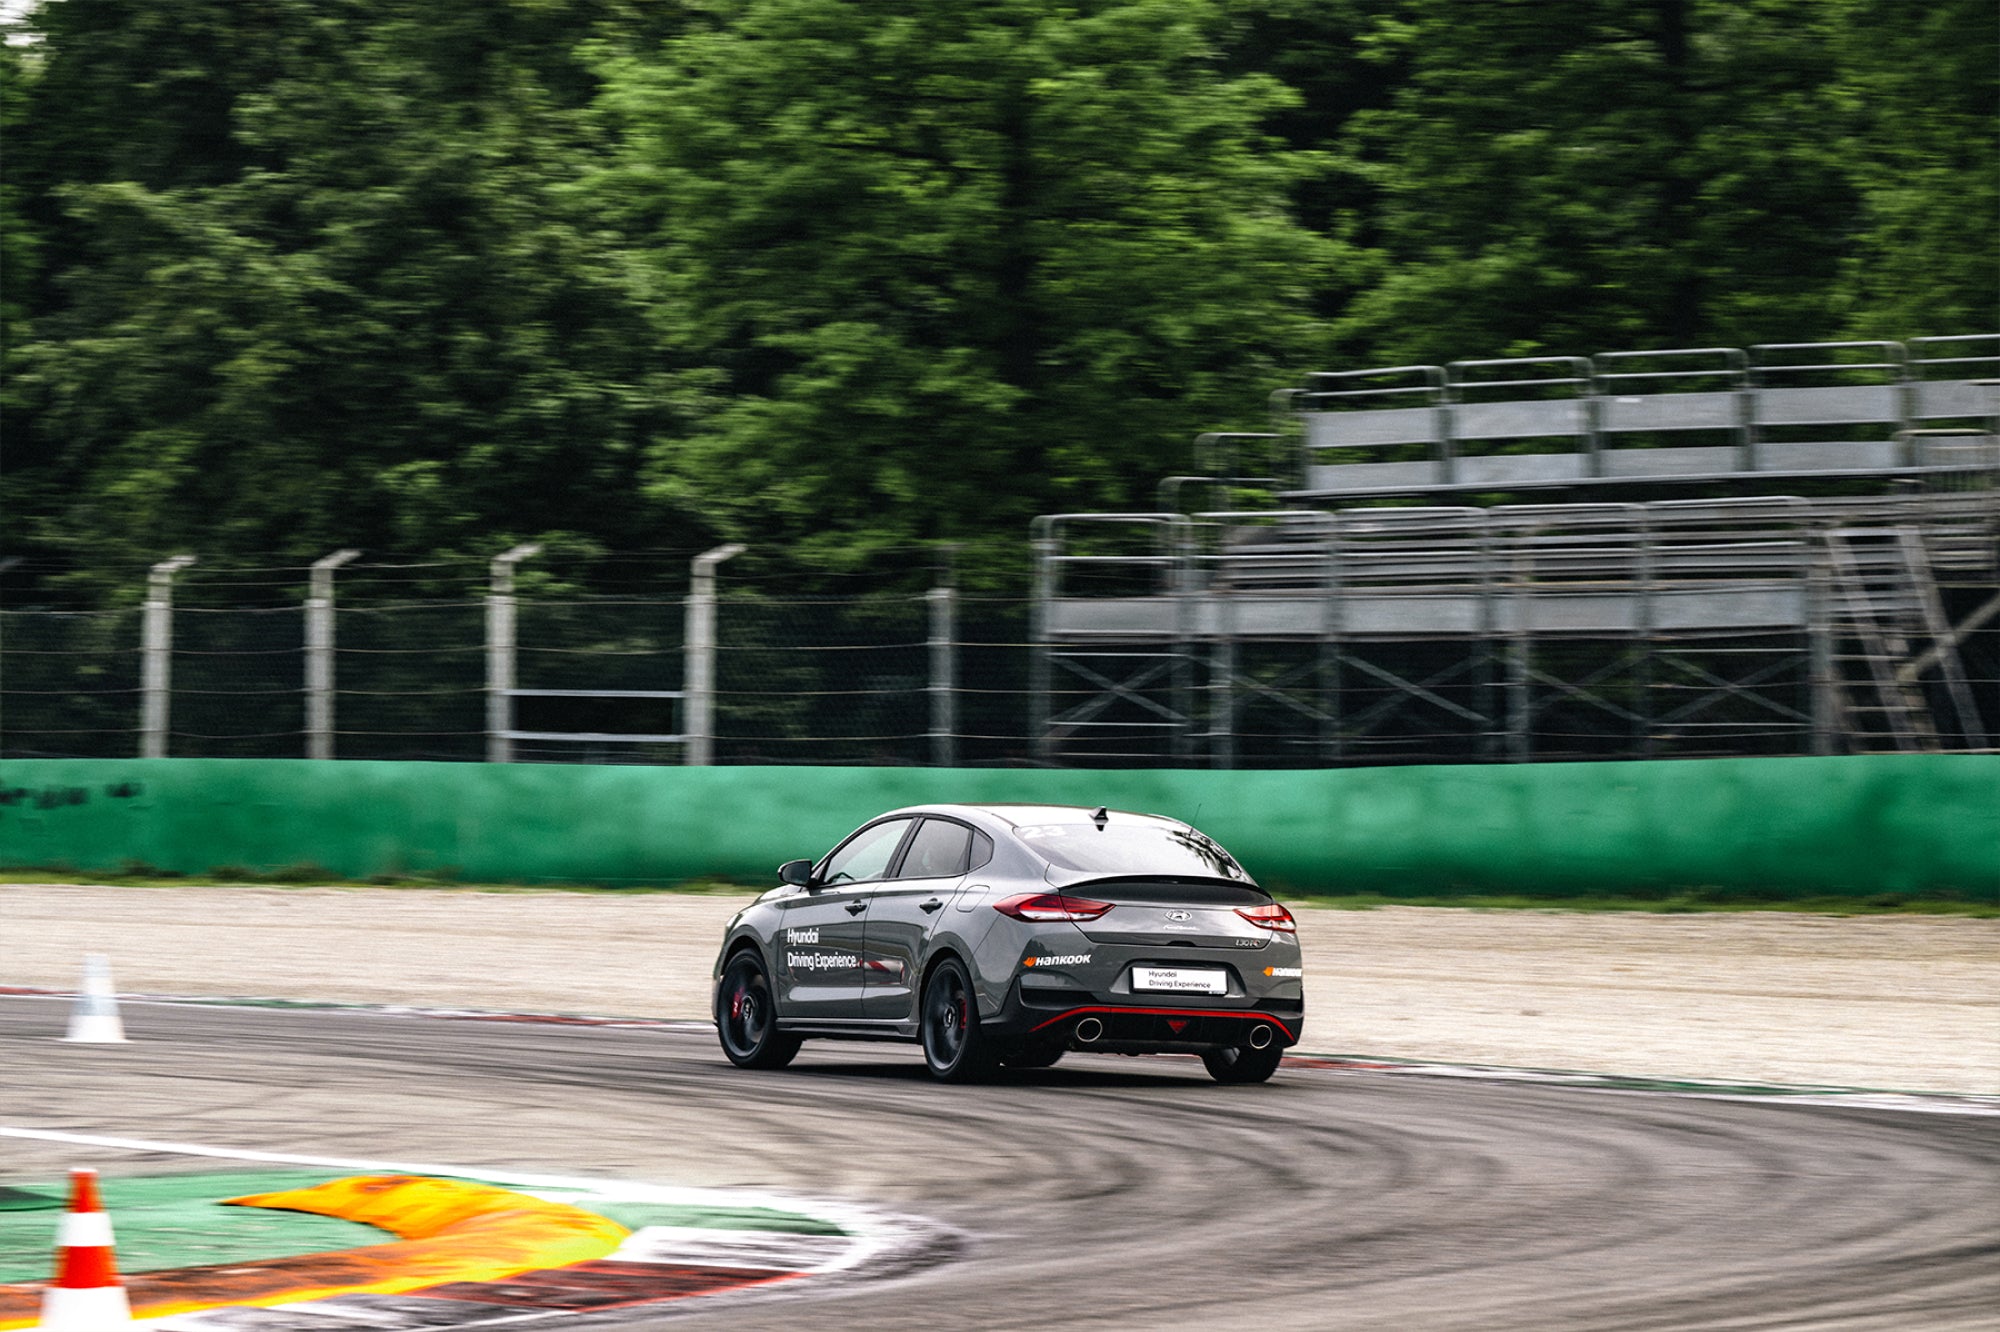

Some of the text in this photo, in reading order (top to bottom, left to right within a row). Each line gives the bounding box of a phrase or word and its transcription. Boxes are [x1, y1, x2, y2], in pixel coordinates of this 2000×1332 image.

[1020, 826, 1066, 839] 23
[787, 928, 819, 946] Hyundai
[787, 952, 857, 971] Driving Experience
[1148, 970, 1177, 978] Hyundai
[1148, 979, 1212, 989] Driving Experience
